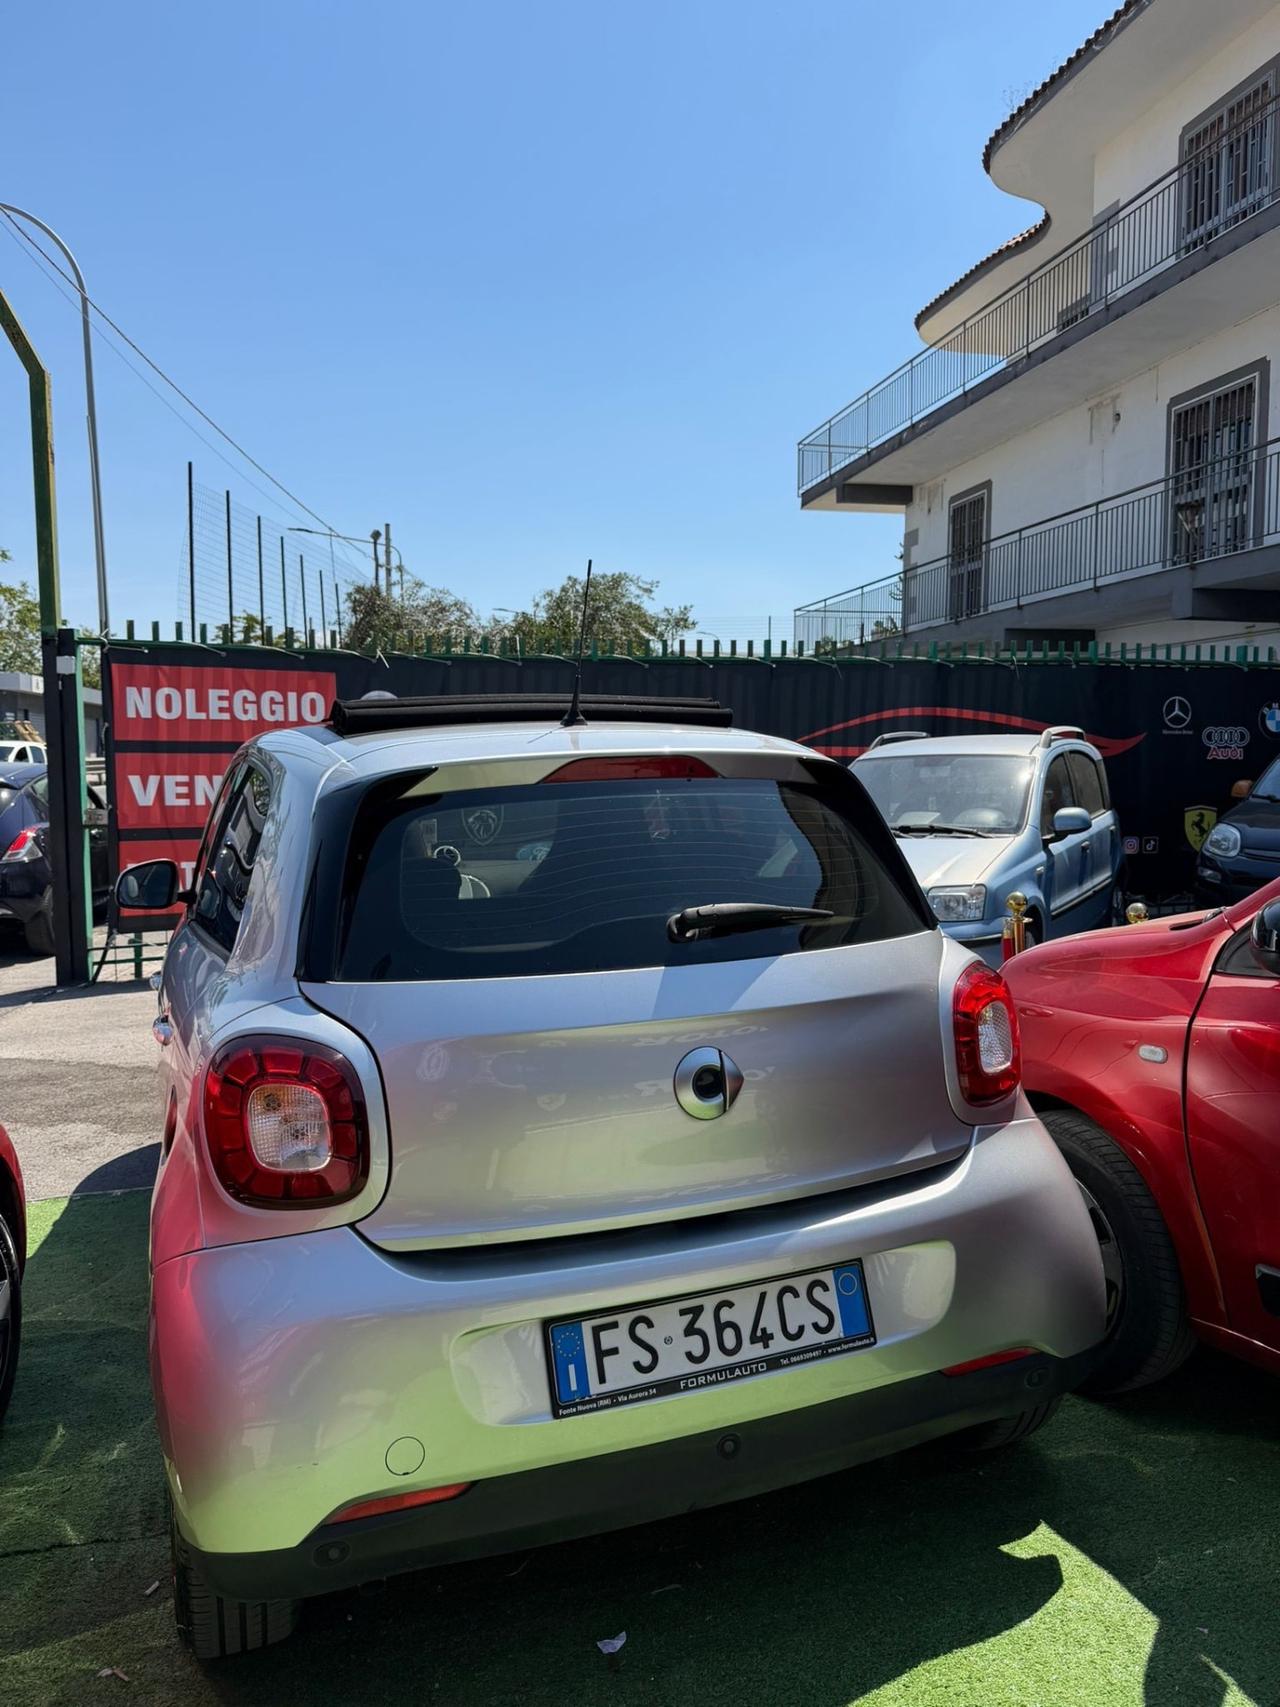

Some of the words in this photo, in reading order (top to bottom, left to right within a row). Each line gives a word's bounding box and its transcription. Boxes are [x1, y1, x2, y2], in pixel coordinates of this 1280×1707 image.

[125, 686, 325, 722] NOLEGGIO
[590, 1315, 660, 1385] FS
[678, 1278, 836, 1365] 364CS
[680, 1362, 767, 1390] FORMULAUTO
[559, 1406, 577, 1416] Fonte
[577, 1402, 597, 1411] Nuova
[617, 1394, 628, 1402] Via
[628, 1389, 648, 1400] Aurora
